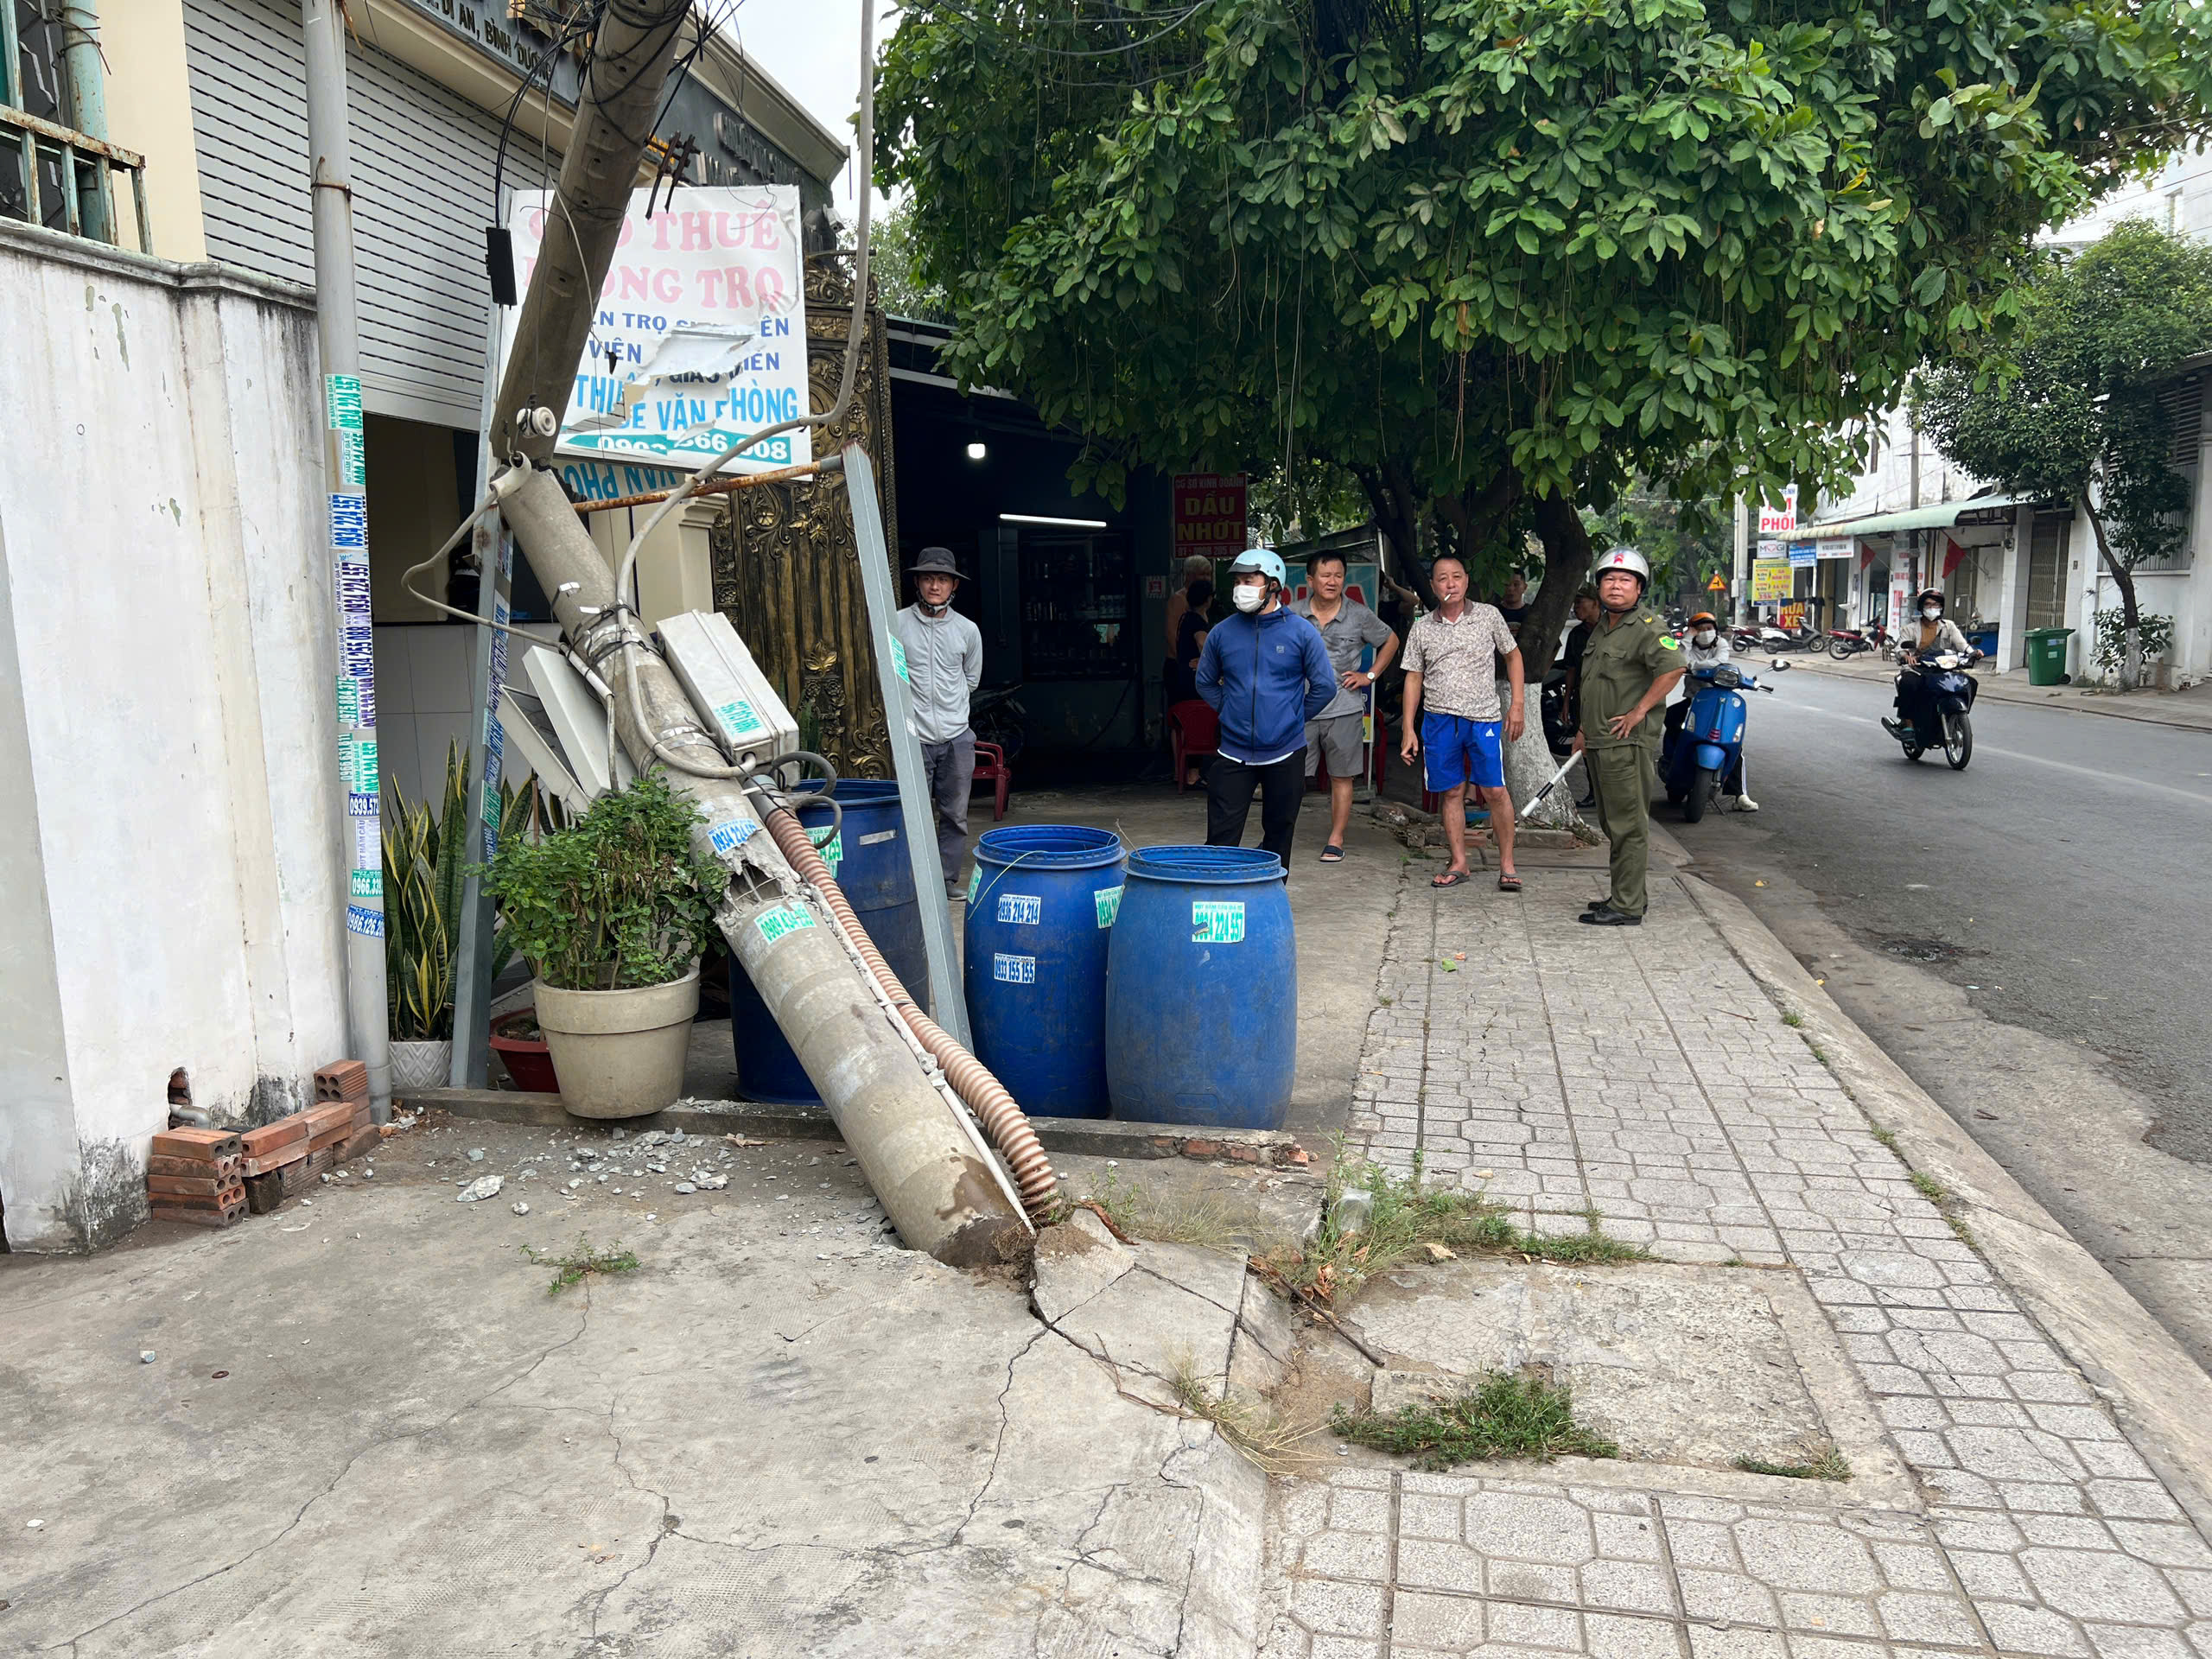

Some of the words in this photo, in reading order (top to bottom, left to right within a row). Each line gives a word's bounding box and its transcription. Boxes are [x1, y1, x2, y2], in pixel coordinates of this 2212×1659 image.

[647, 199, 780, 251] THUÊ
[696, 266, 784, 312] TRỌ
[622, 313, 667, 335] TRỌ
[334, 375, 361, 391] 557
[335, 392, 362, 409] 224
[657, 392, 707, 431] VĂN
[1177, 518, 1243, 541] NHỚT
[1761, 512, 1795, 531] PHỔI
[341, 562, 369, 576] 557
[342, 577, 370, 593] 224
[343, 594, 371, 613] 0934
[345, 626, 372, 640] 088
[346, 641, 372, 657] 255
[347, 657, 373, 677] 0934
[712, 827, 734, 852] 0934
[1013, 901, 1025, 923] 214
[1026, 902, 1039, 924] 214
[760, 912, 782, 943] 0989
[1215, 912, 1230, 941] 224
[1230, 912, 1243, 941] 557
[995, 958, 1007, 980] 0933
[1008, 960, 1020, 982] 155
[1022, 961, 1035, 983] 155
